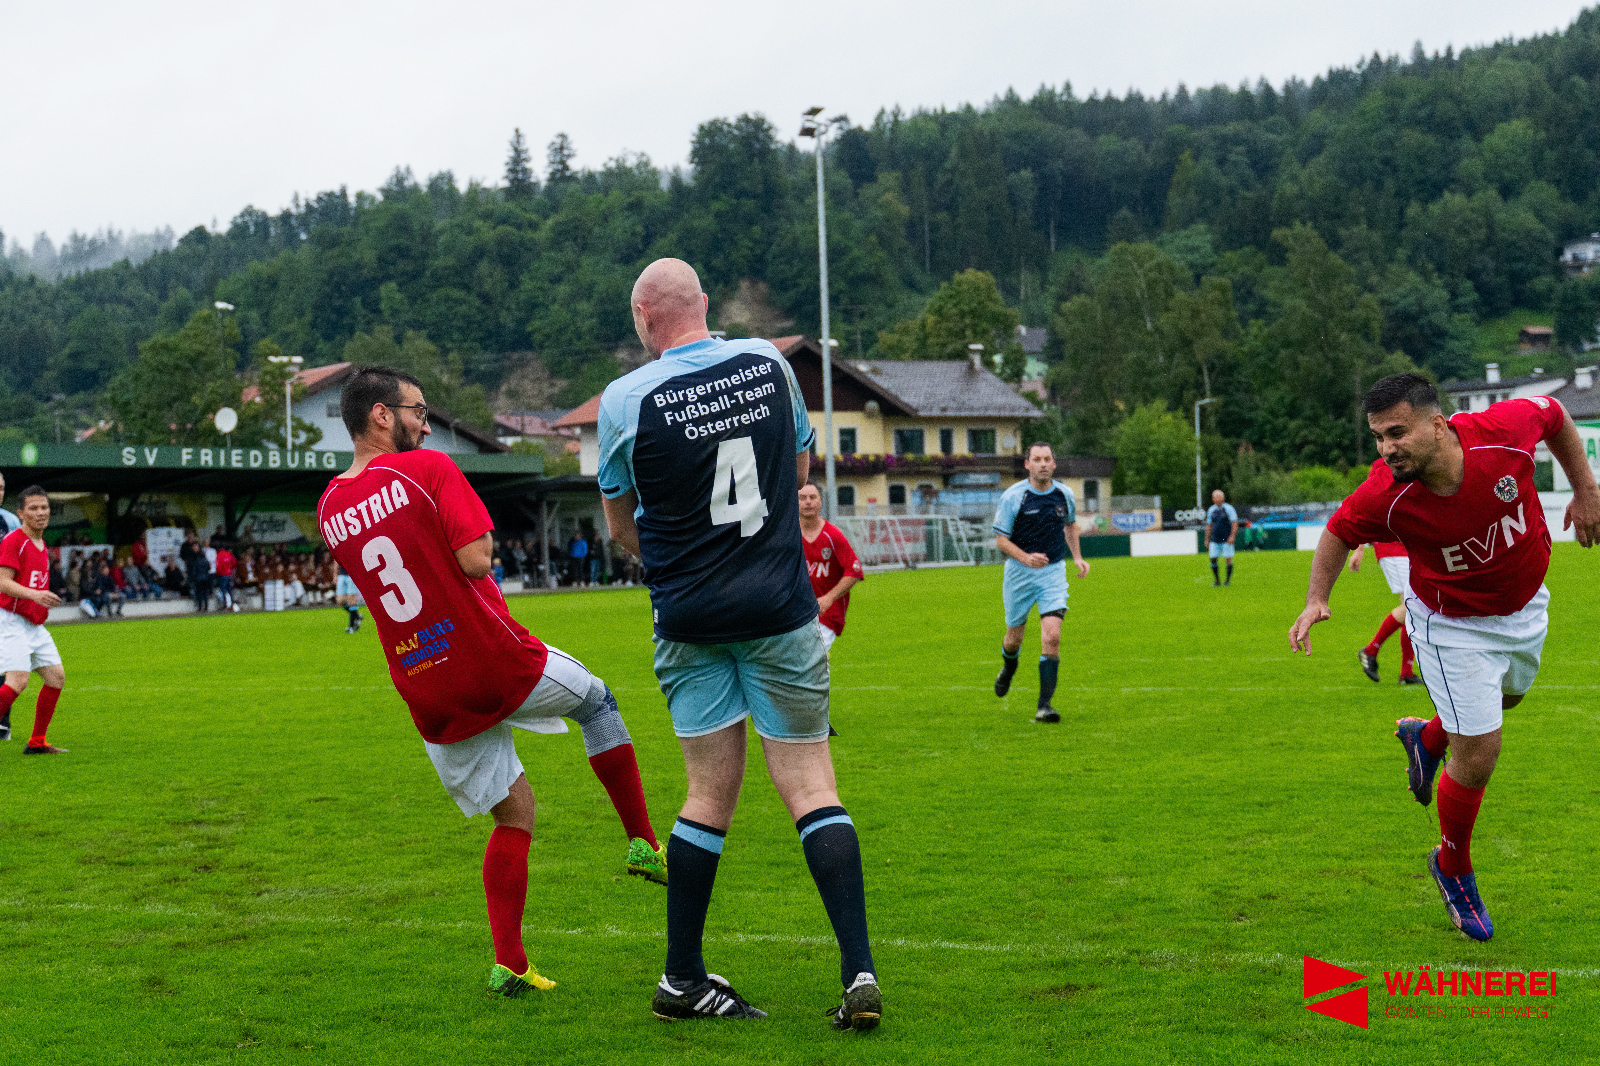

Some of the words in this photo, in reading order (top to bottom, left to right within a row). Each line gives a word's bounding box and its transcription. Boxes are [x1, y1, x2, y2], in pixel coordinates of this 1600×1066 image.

[653, 362, 773, 408] Bürgermeister
[664, 382, 776, 426] Fußball-Team
[684, 404, 771, 440] Österreich
[122, 446, 158, 467] SV
[181, 448, 337, 469] FRIEDBURG
[709, 435, 769, 538] 4
[323, 479, 410, 549] AUSTRIA
[1441, 501, 1527, 573] EVN
[361, 535, 423, 623] 3
[806, 561, 830, 578] VN
[401, 638, 450, 669] HEMDEN
[407, 660, 434, 677] AUSTRIA
